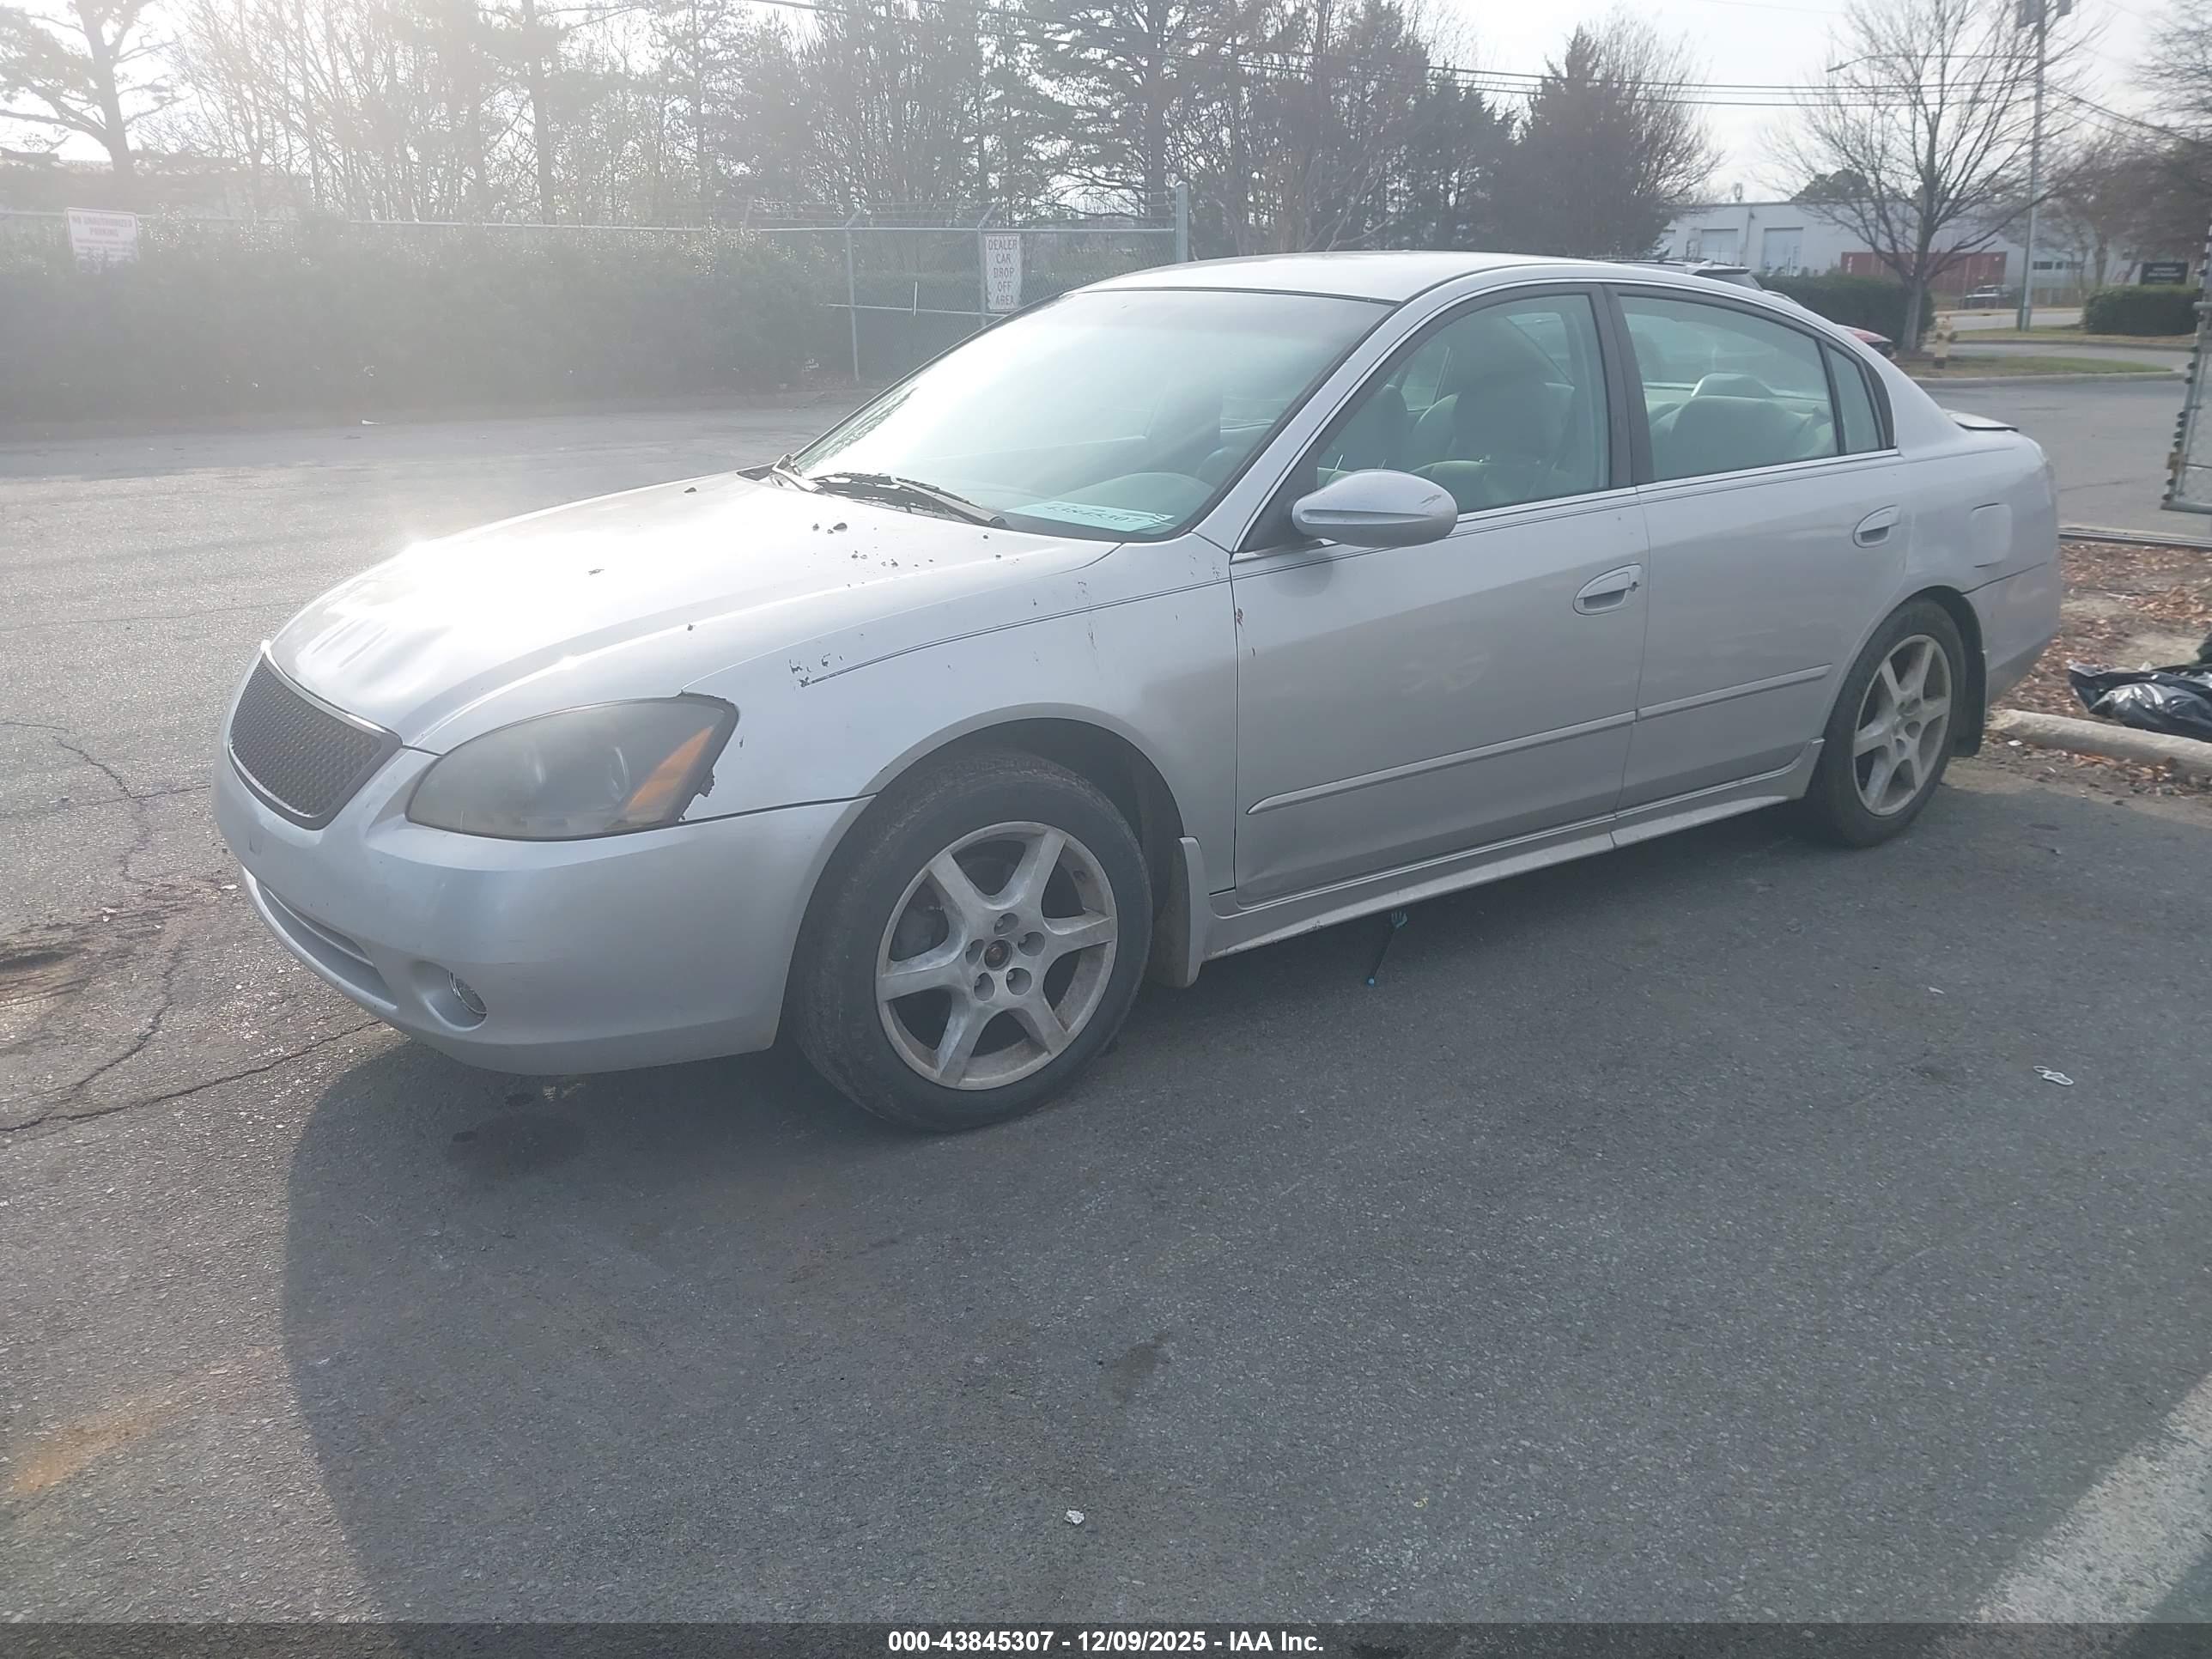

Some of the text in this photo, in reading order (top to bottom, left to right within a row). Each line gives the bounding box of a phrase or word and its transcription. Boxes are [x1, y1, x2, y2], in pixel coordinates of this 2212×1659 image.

[988, 239, 1018, 250] DEALER
[996, 253, 1011, 264] CAR
[994, 267, 1015, 278] DROP
[997, 281, 1012, 292] OFF
[995, 295, 1015, 305] AREA
